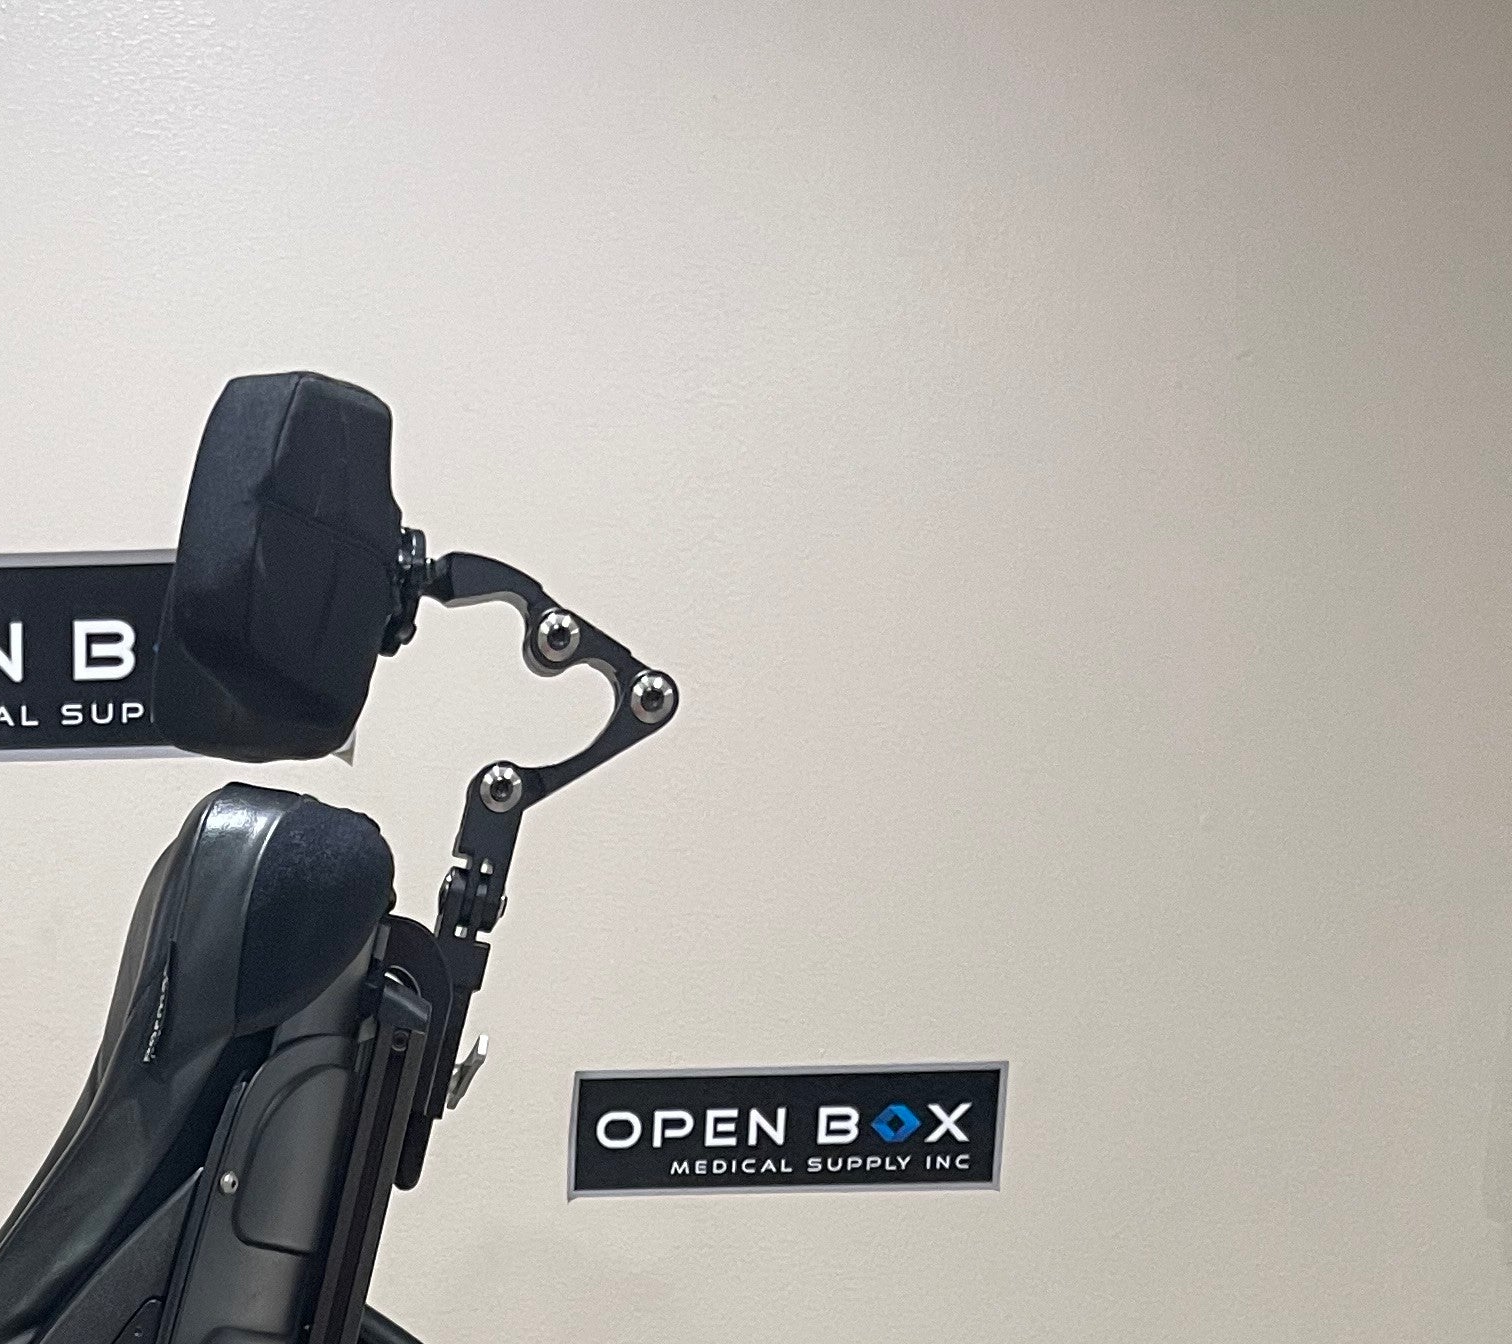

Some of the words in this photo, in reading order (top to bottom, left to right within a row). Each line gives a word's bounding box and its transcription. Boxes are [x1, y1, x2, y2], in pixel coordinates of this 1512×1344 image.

[59, 701, 154, 726] SUP
[595, 1106, 788, 1149] OPEN
[816, 1101, 973, 1145] BOX
[670, 1157, 793, 1175] MEDICAL
[806, 1154, 912, 1173] SUPPLY
[925, 1153, 971, 1170] INC
